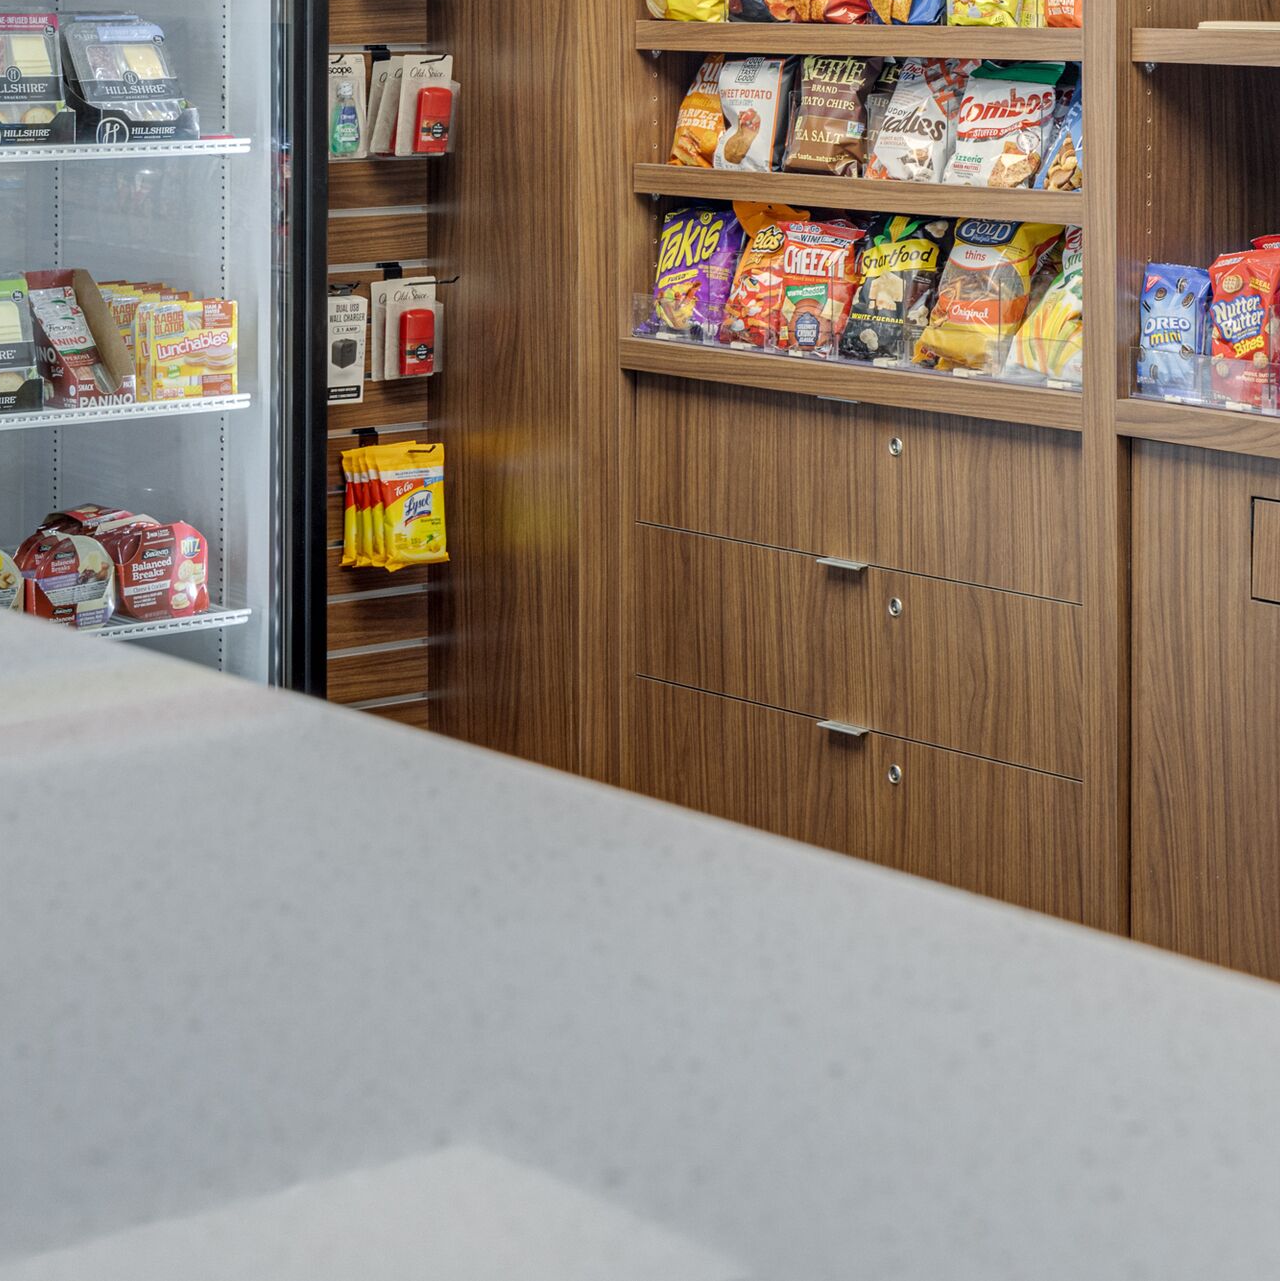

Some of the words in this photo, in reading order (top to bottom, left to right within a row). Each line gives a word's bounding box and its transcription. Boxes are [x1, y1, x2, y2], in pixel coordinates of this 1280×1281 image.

[30, 16, 49, 24] SALAME
[328, 65, 353, 76] scope
[105, 84, 166, 95] HILLSHIRE
[740, 90, 772, 100] POTATO
[812, 84, 838, 94] BRAND
[826, 98, 855, 111] CHIPS
[959, 89, 1054, 124] Combos
[3, 129, 50, 138] HILLSHIRE
[131, 127, 176, 135] HILLSHIRE
[973, 128, 999, 138] STUFFED
[809, 130, 844, 145] SALT
[961, 218, 1011, 241] GOLD
[656, 212, 724, 283] Takis
[965, 250, 987, 262] thins
[393, 290, 408, 302] Old
[336, 304, 348, 313] DUAL
[349, 303, 360, 312] USB
[951, 304, 989, 320] Original
[1213, 296, 1260, 324] Nutter
[330, 315, 342, 323] WALL
[343, 313, 365, 322] CHARGER
[851, 313, 871, 321] WHITE
[1143, 317, 1191, 334] OREO
[1220, 310, 1264, 339] Butter
[1150, 330, 1182, 347] mini
[157, 332, 228, 360] Lunchables
[1234, 336, 1265, 358] Bites
[80, 393, 133, 408] PANINO
[394, 487, 403, 496] To
[403, 482, 414, 494] Go
[405, 494, 431, 515] Lysol
[51, 559, 76, 568] Balanced
[132, 557, 172, 571] Balanced
[132, 568, 164, 580] Breaks
[133, 585, 148, 593] Cheese
